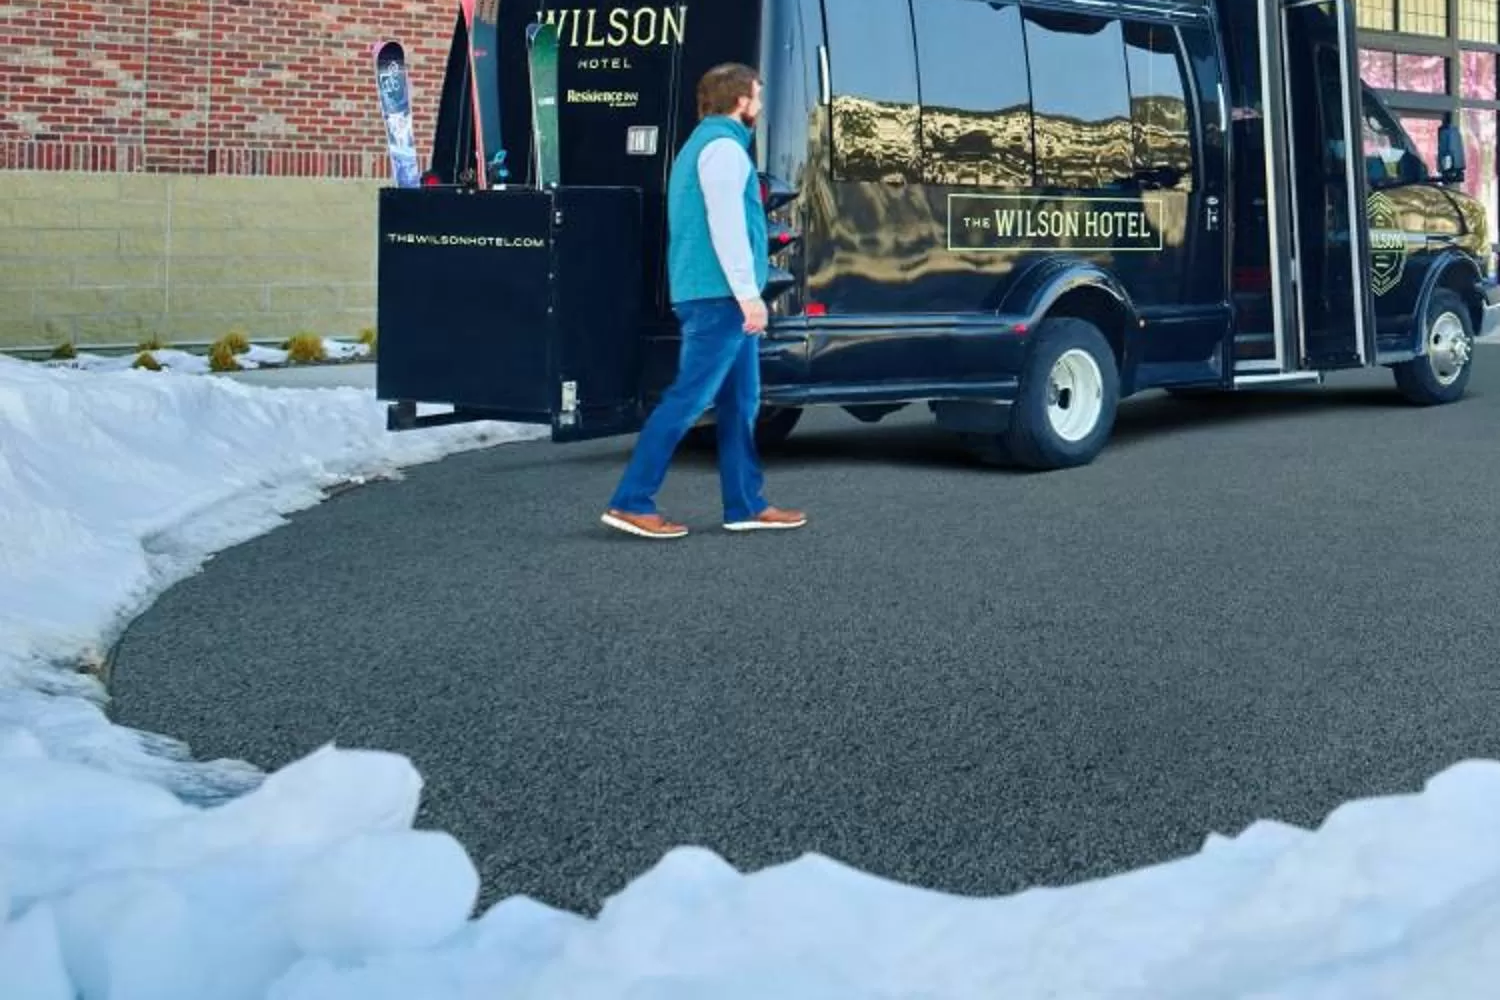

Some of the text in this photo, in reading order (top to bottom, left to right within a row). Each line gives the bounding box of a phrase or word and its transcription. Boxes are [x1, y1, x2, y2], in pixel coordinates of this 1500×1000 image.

[577, 57, 632, 69] HOTEL
[963, 209, 1151, 237] THE WILSON HOTEL
[387, 233, 545, 247] THEWILSONHOTEL.COM
